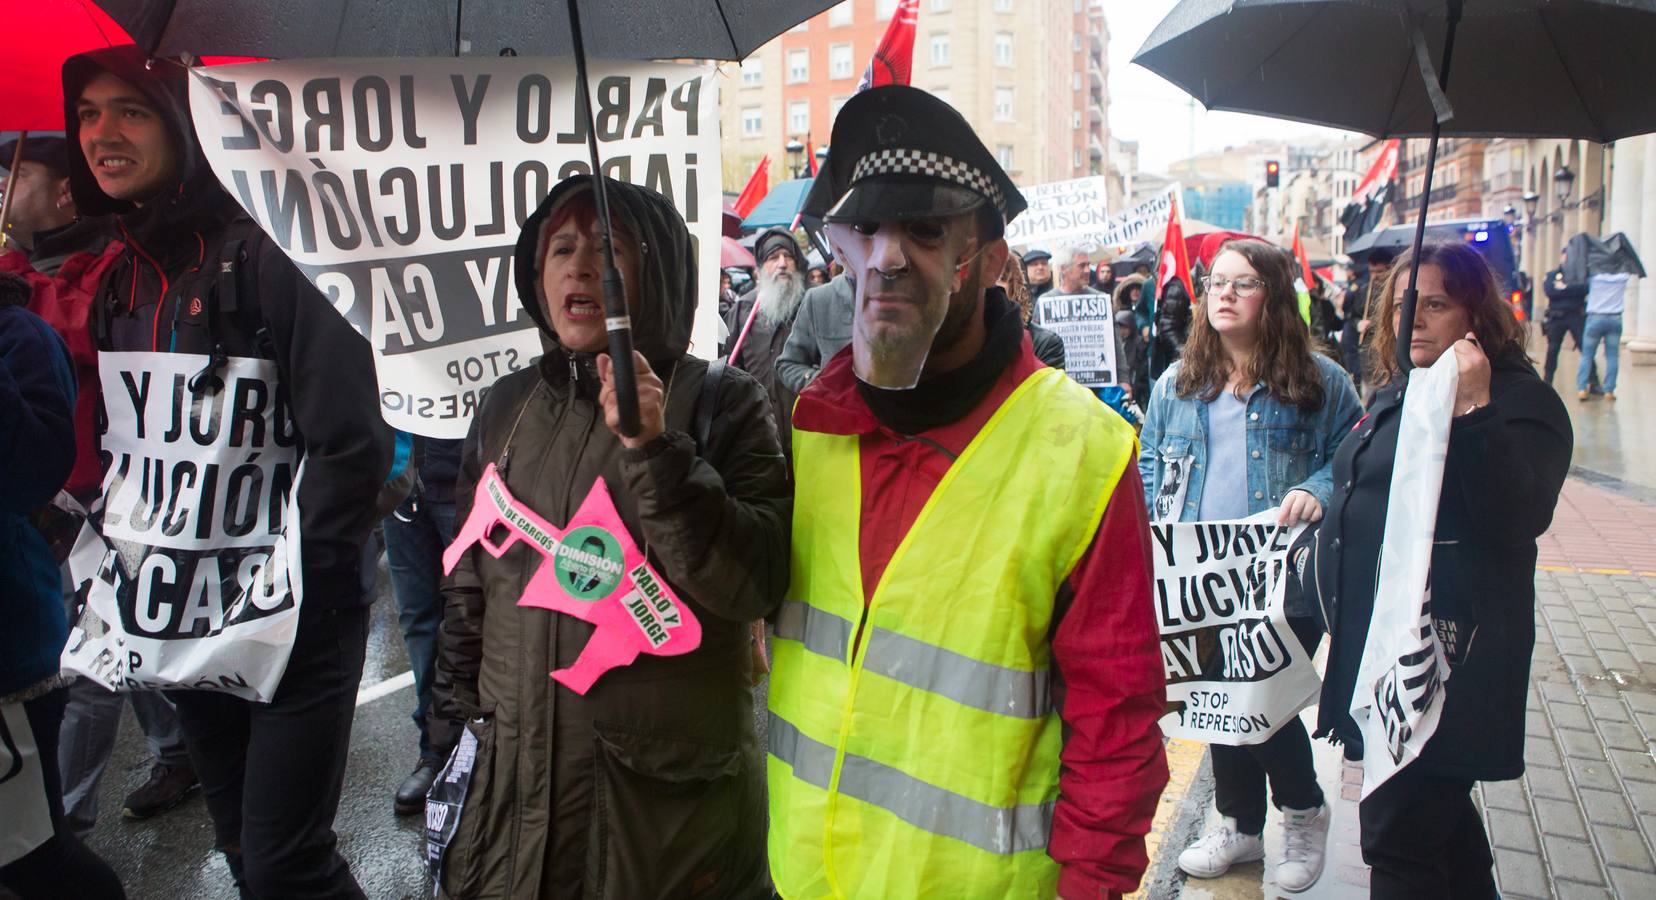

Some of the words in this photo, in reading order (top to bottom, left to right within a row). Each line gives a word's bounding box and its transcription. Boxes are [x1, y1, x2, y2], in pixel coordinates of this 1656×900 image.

[1004, 204, 1107, 240] DIMISIÓN
[1072, 299, 1106, 317] CASO
[119, 370, 151, 439] Y
[504, 508, 519, 521] DE
[517, 517, 554, 550] CARGOS
[1150, 524, 1176, 566] Y
[559, 544, 623, 575] DIMISIÓN
[632, 566, 671, 613] PABLO
[664, 613, 679, 623] Y
[628, 598, 668, 645] JORGE
[1190, 691, 1229, 710] STOP
[1191, 712, 1271, 734] REPRESIÓN
